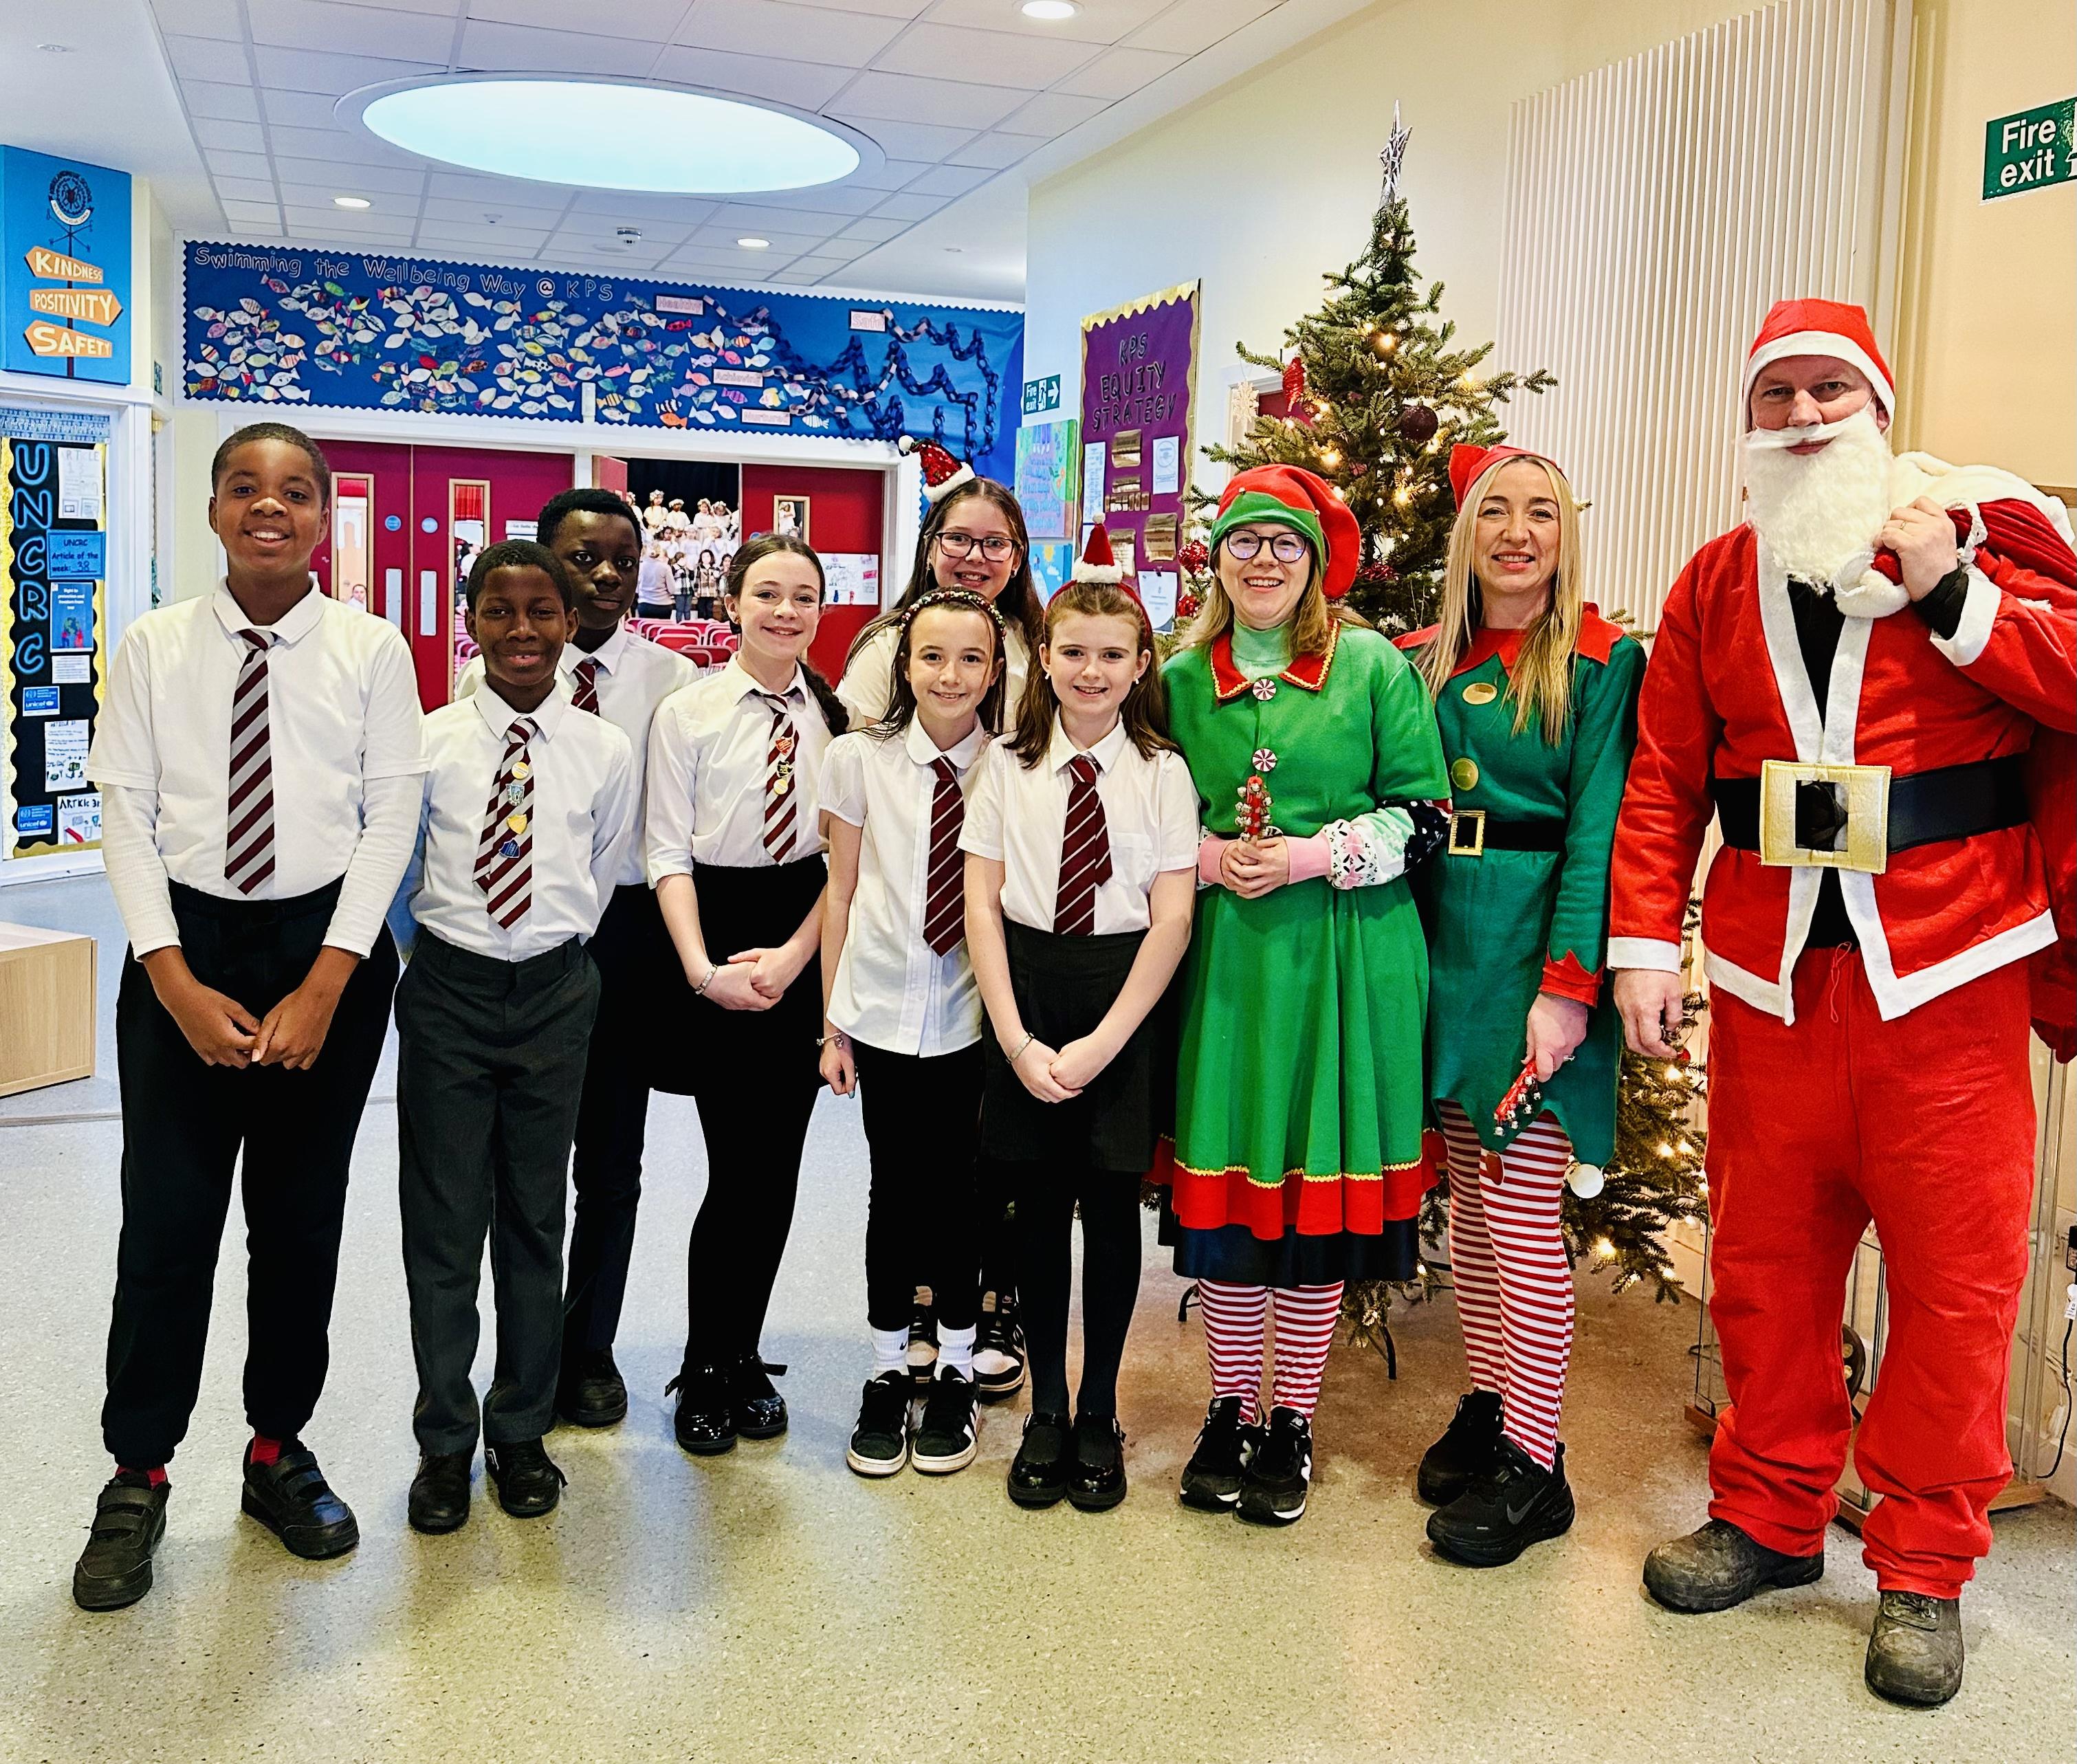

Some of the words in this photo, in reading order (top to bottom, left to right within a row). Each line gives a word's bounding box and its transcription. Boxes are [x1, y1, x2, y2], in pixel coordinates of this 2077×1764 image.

[2001, 119, 2056, 154] Fire
[2000, 148, 2055, 188] exit
[35, 251, 103, 281] KINDNESS
[194, 247, 302, 278] Swimming
[314, 258, 350, 279] the
[363, 258, 470, 293] Wellbeing
[480, 274, 526, 300] Way
[536, 278, 556, 298] @
[34, 293, 113, 322] POSITIVITY
[33, 326, 111, 355] SAFETY
[1119, 332, 1148, 367] KPS
[1026, 384, 1037, 398] Fire
[1100, 360, 1167, 403] EQUITY
[1025, 397, 1037, 412] exit
[1092, 393, 1177, 432] STRATEGY
[61, 450, 100, 461] ARTCLE
[63, 538, 88, 547] UNCRC
[77, 551, 85, 560] of
